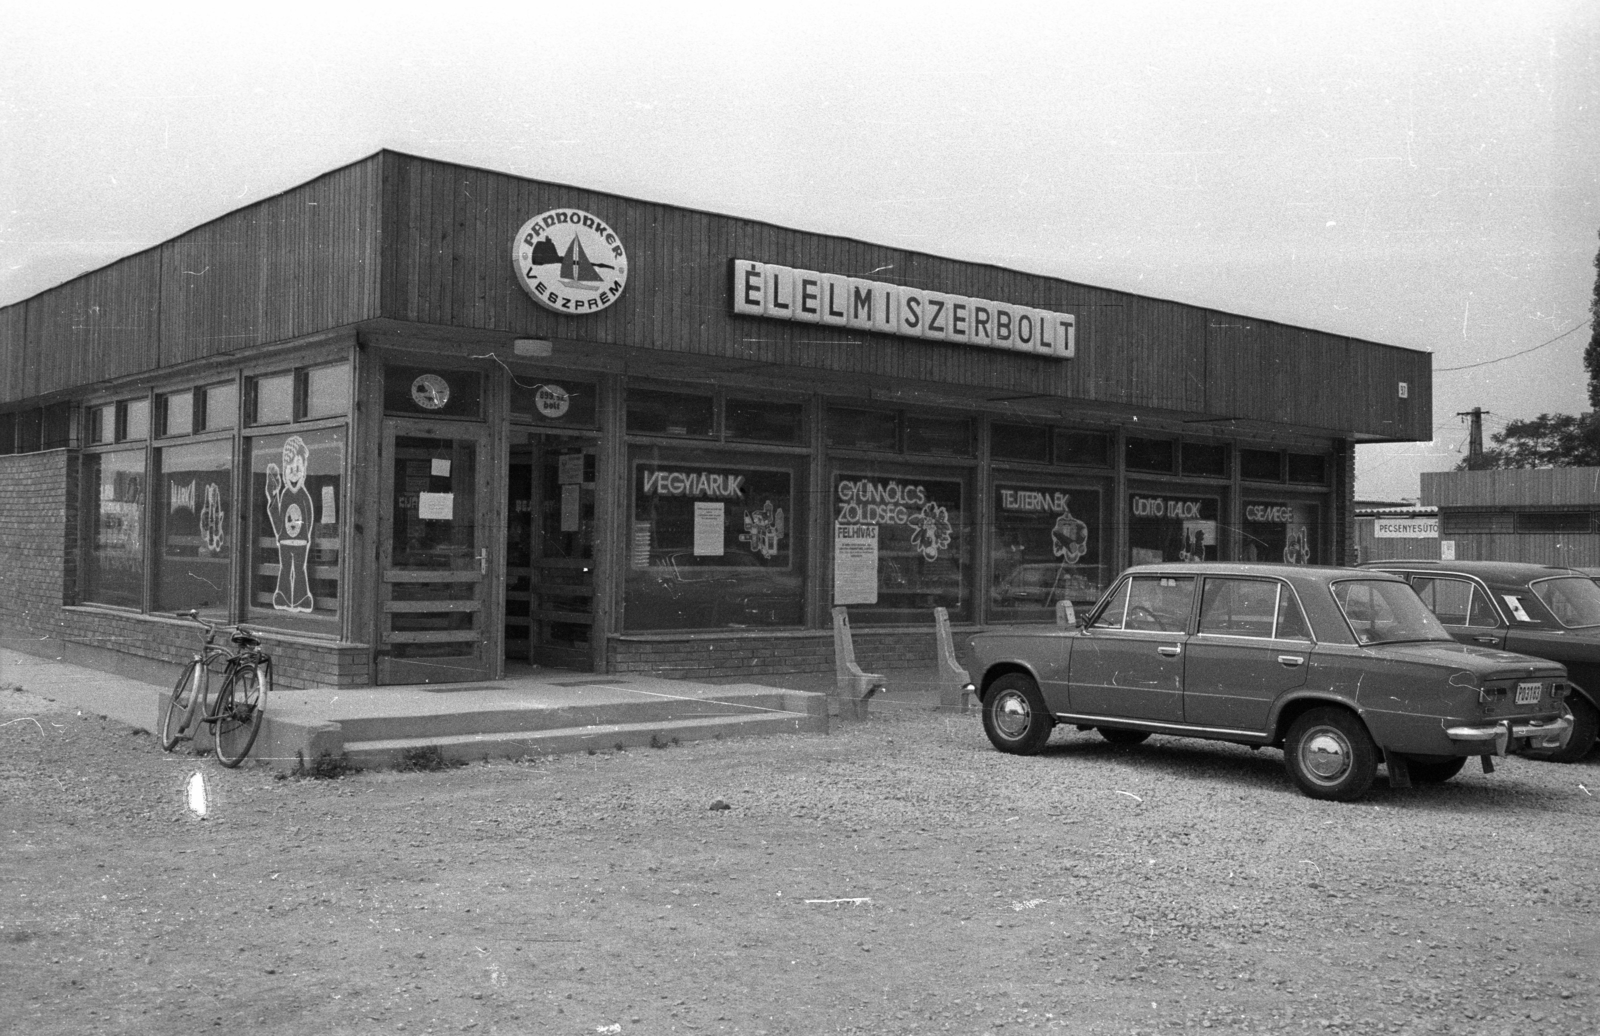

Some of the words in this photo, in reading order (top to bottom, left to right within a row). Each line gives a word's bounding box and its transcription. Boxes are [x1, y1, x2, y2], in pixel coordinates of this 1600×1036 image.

[523, 211, 623, 260] PANNONKER
[526, 267, 622, 310] VESZPRÉM
[744, 263, 1074, 350] ÉLELMISZERBOLT
[544, 401, 560, 410] bolt
[644, 470, 745, 497] VEGYIÁRUK
[838, 479, 926, 504] GYÜMÖLCS
[1001, 489, 1070, 512] TEJTERMÉK
[1167, 501, 1201, 519] ITALOK
[838, 501, 909, 524] ZÖLDSÉG
[1246, 505, 1293, 523] CSEMEGE
[838, 526, 876, 539] FELHÍVÁS
